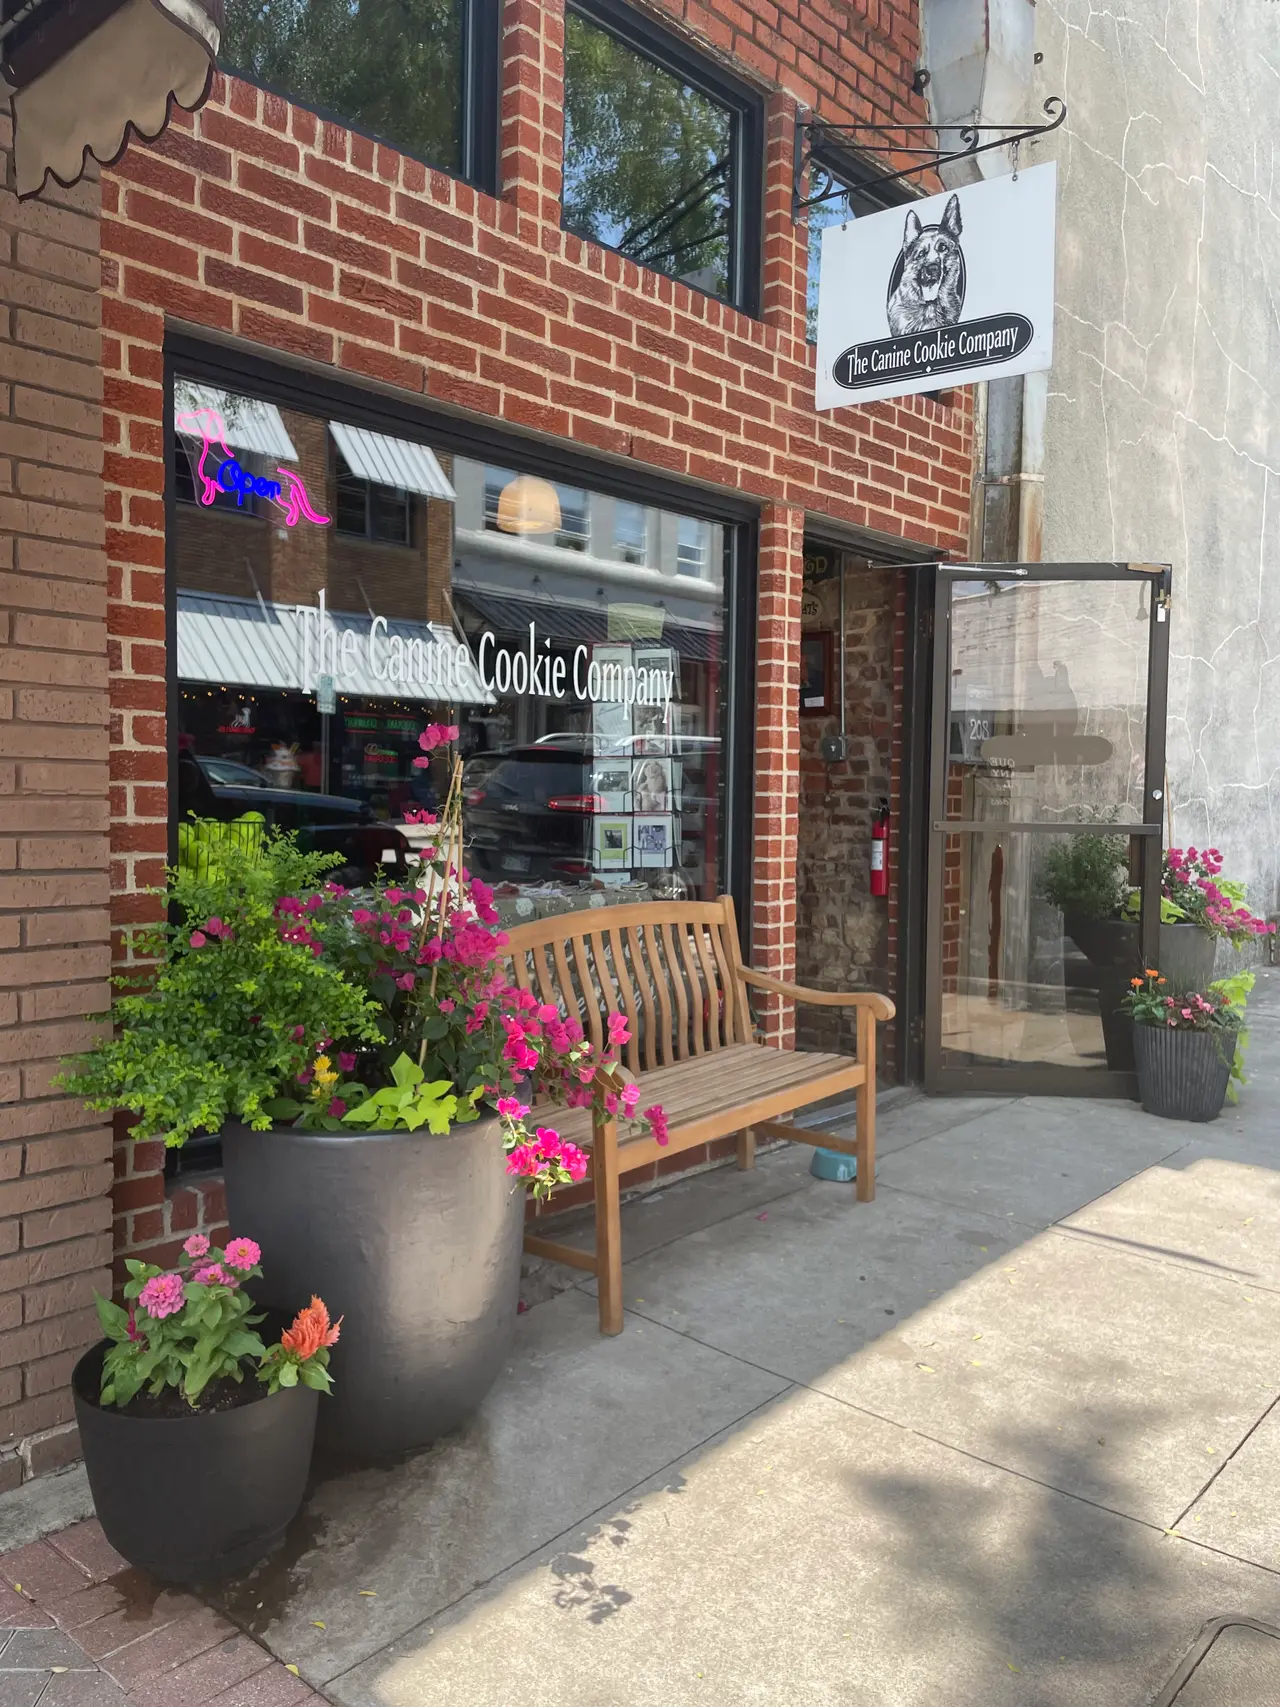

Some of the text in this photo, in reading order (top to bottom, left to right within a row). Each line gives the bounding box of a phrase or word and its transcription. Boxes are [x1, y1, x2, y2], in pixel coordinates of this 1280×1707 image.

[847, 326, 1019, 383] The Canine Cookie Company
[217, 459, 281, 506] Open
[296, 588, 358, 694] The
[369, 616, 471, 688] Canine
[479, 621, 567, 698] Cookie
[573, 645, 674, 723] Company
